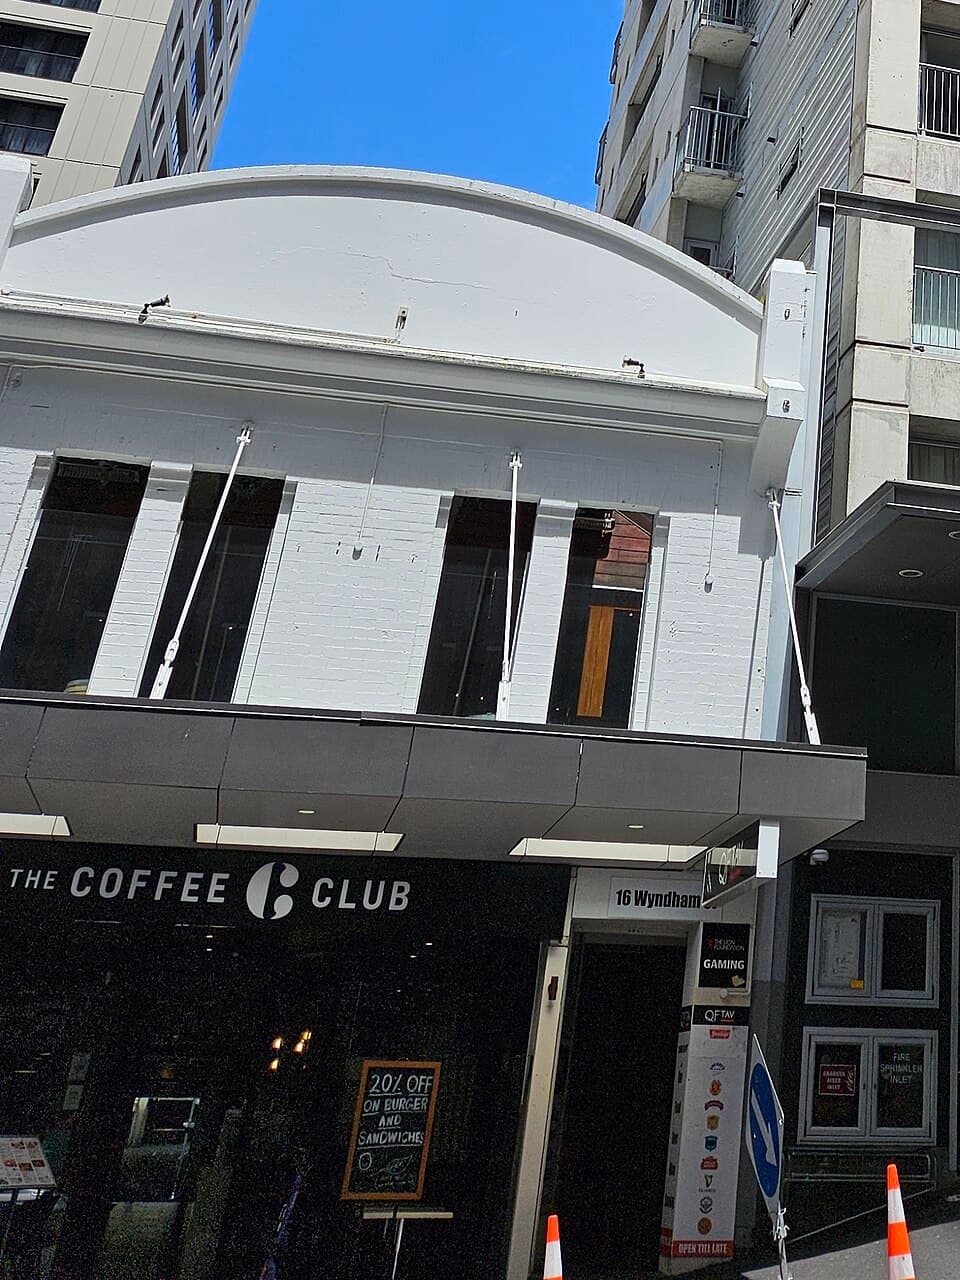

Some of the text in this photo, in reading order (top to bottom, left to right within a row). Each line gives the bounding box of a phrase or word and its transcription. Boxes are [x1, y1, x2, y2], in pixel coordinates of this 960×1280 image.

[10, 869, 58, 890] THE
[70, 866, 230, 903] COFFEE
[312, 877, 411, 911] CLUB
[616, 889, 700, 909] 16 Wyndham
[703, 959, 745, 970] GAMING
[369, 1073, 434, 1093] 20% OFF
[363, 1097, 429, 1112] ON BURGER
[379, 1114, 402, 1127] AND
[358, 1131, 425, 1145] SANDWICHES
[678, 1242, 697, 1254] OPEN
[713, 1242, 728, 1254] LATE
